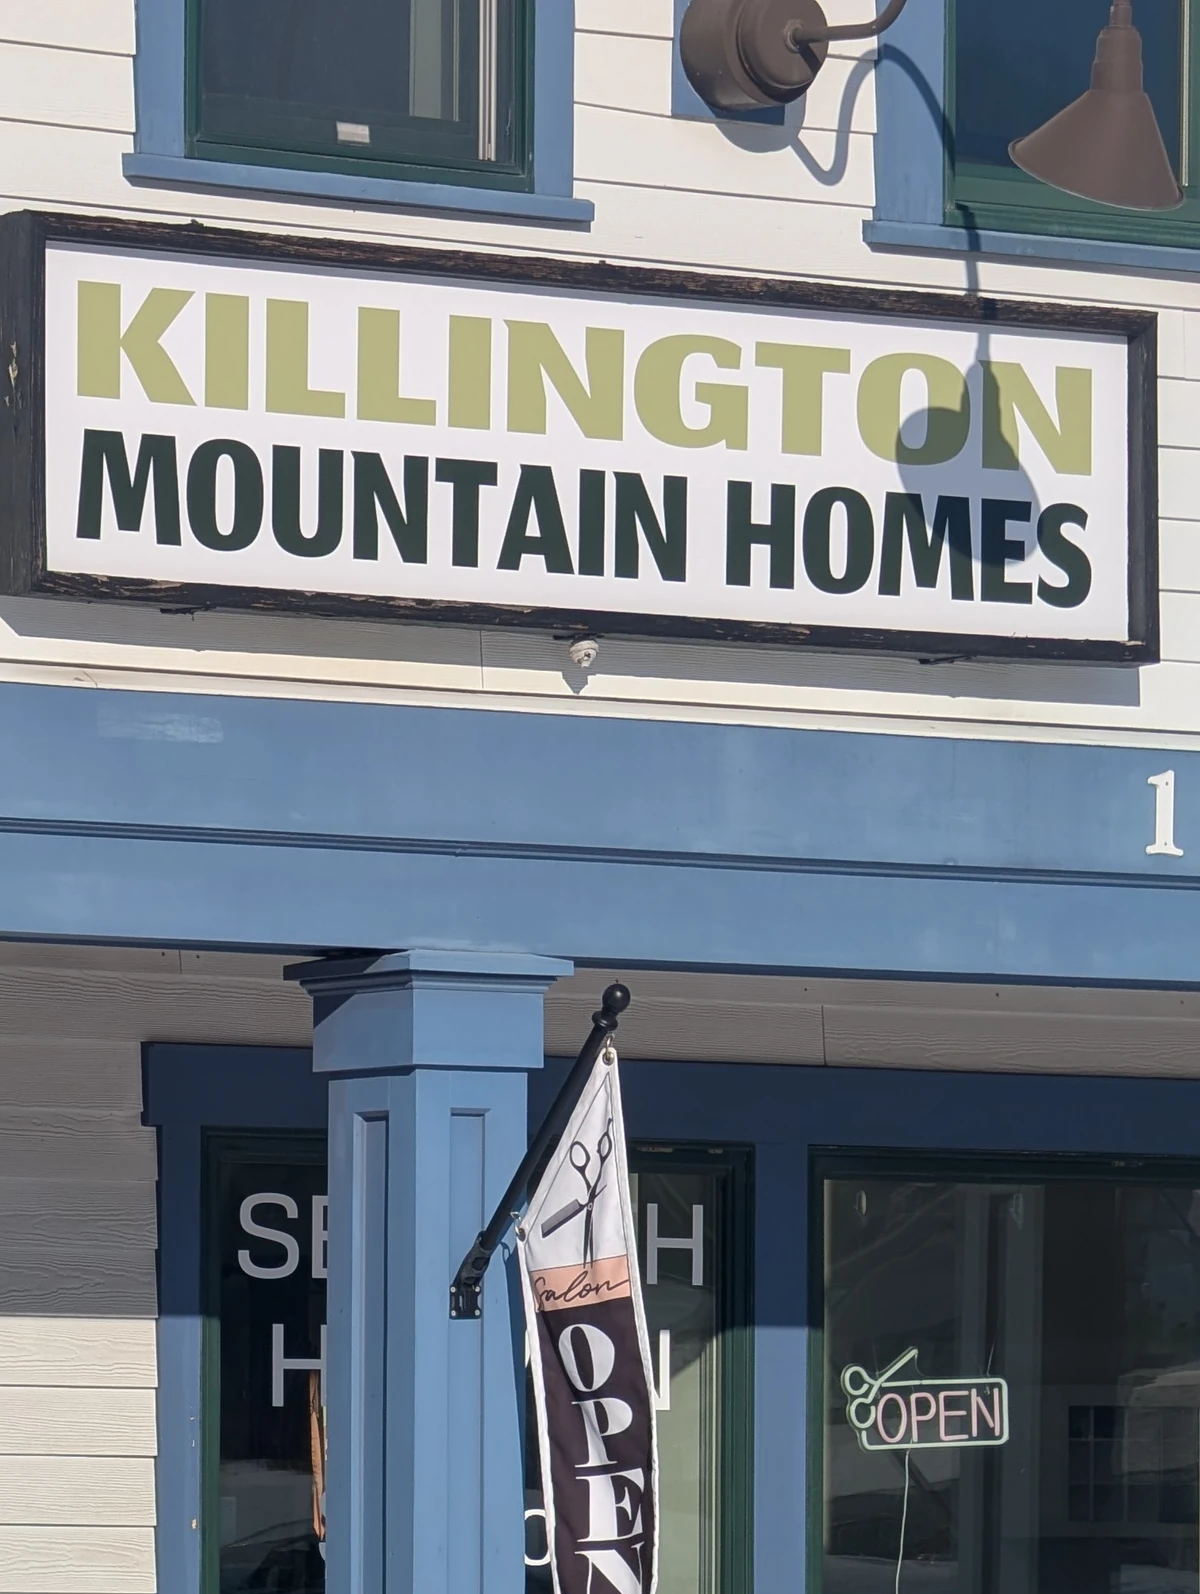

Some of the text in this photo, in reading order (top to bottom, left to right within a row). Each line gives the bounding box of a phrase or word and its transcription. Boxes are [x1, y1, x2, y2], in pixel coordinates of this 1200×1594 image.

[77, 280, 1092, 476] KILLINGTON
[76, 428, 1092, 608] MOUNTAIN HOMES
[1145, 769, 1184, 856] 1
[533, 1270, 630, 1312] Salon
[876, 1387, 1000, 1444] OPEN
